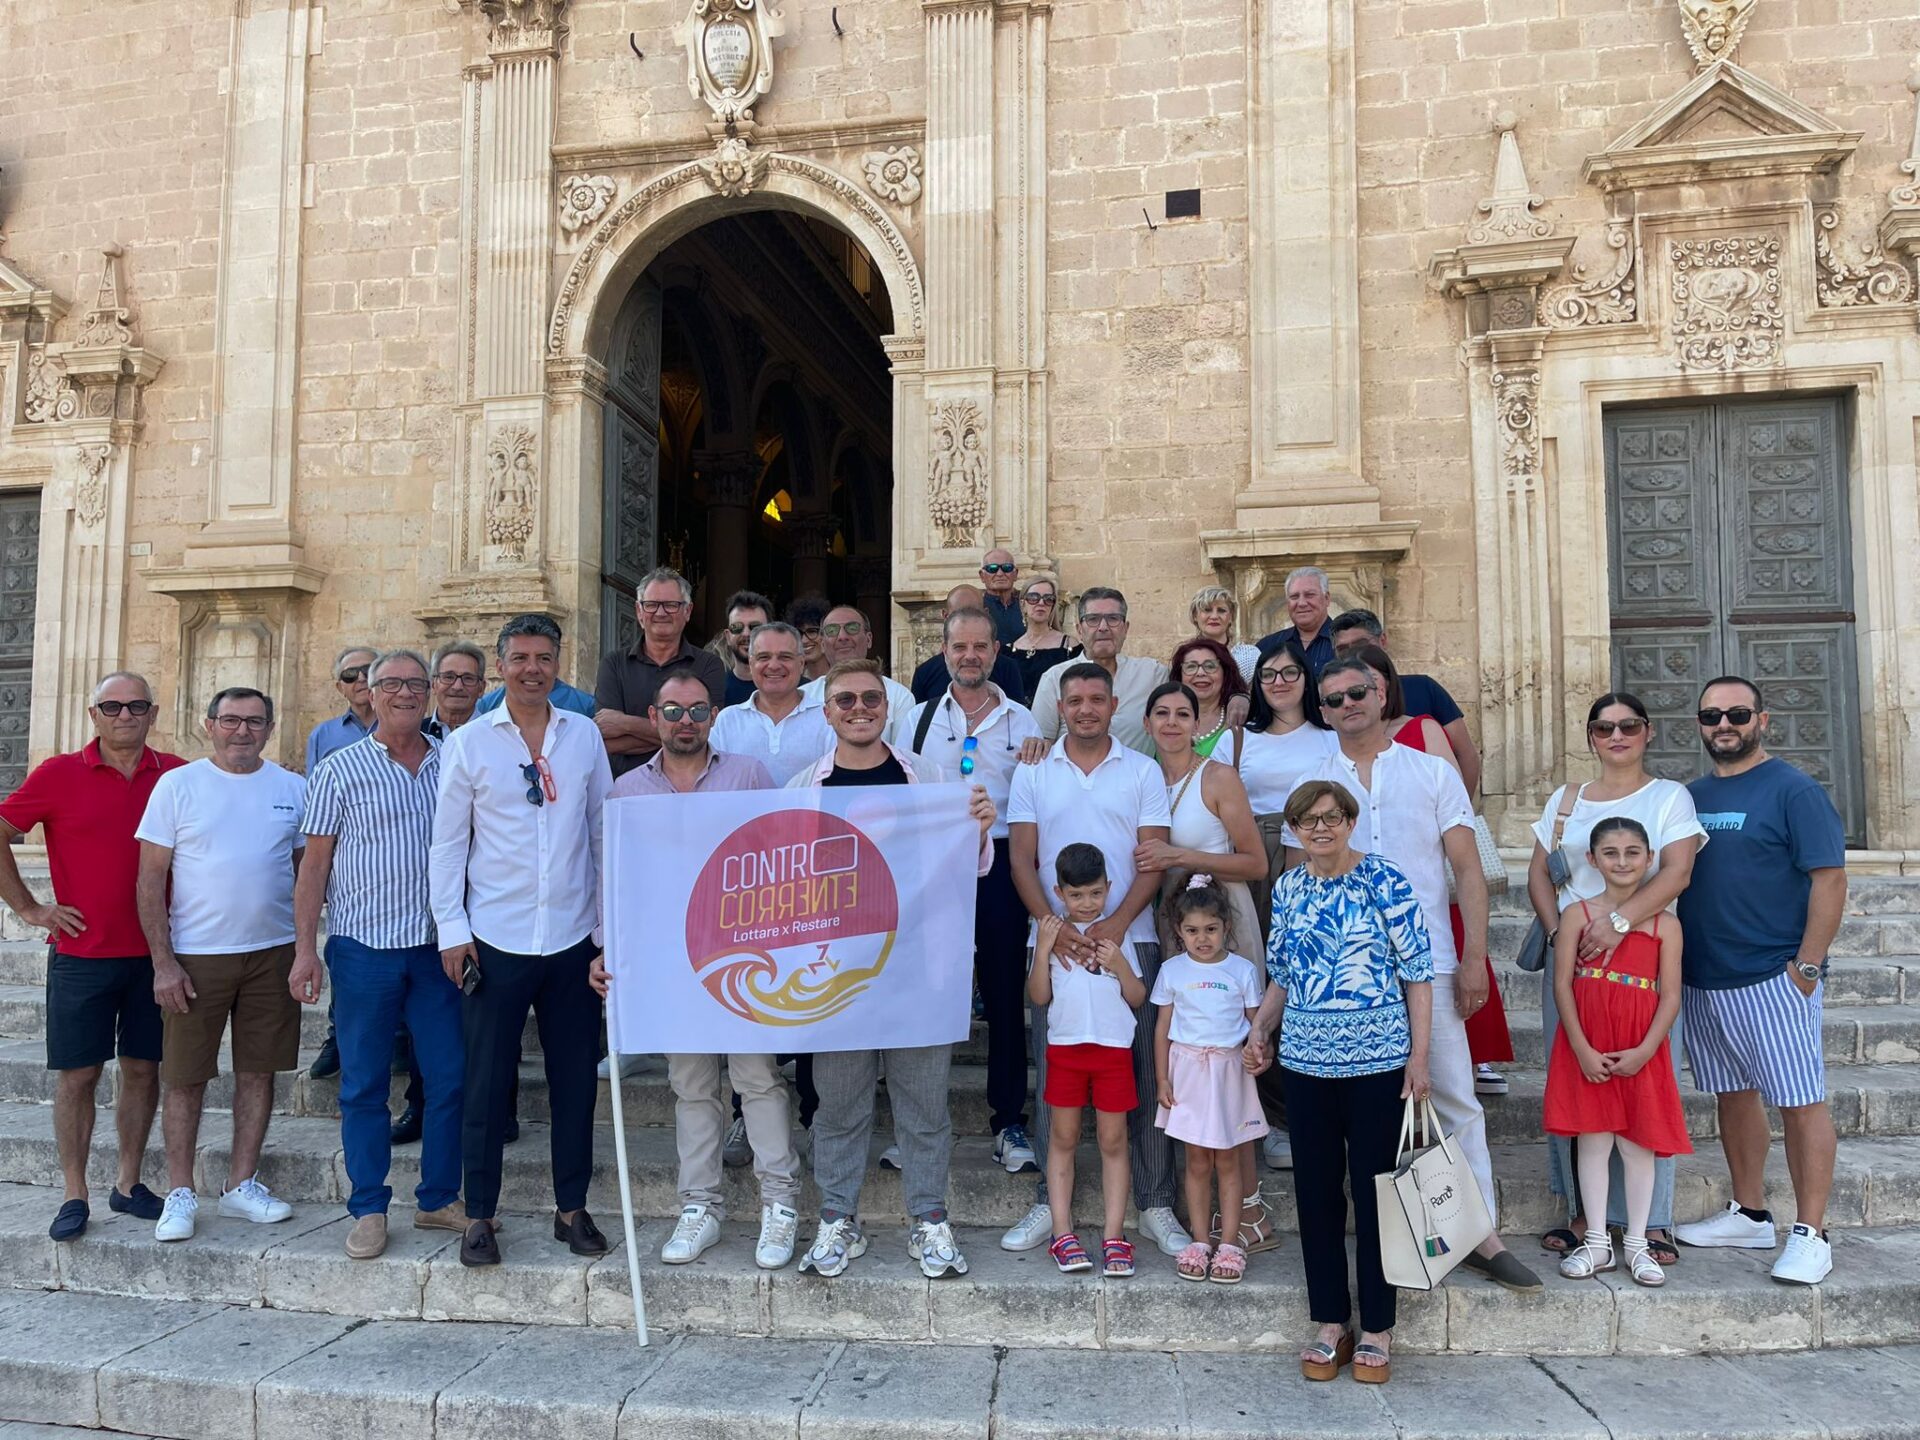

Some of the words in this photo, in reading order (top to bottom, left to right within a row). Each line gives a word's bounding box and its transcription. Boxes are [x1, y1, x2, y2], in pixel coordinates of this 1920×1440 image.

[722, 834, 859, 892] CONTRO
[733, 927, 780, 943] Lottare
[782, 925, 790, 936] x
[792, 915, 841, 933] Restare
